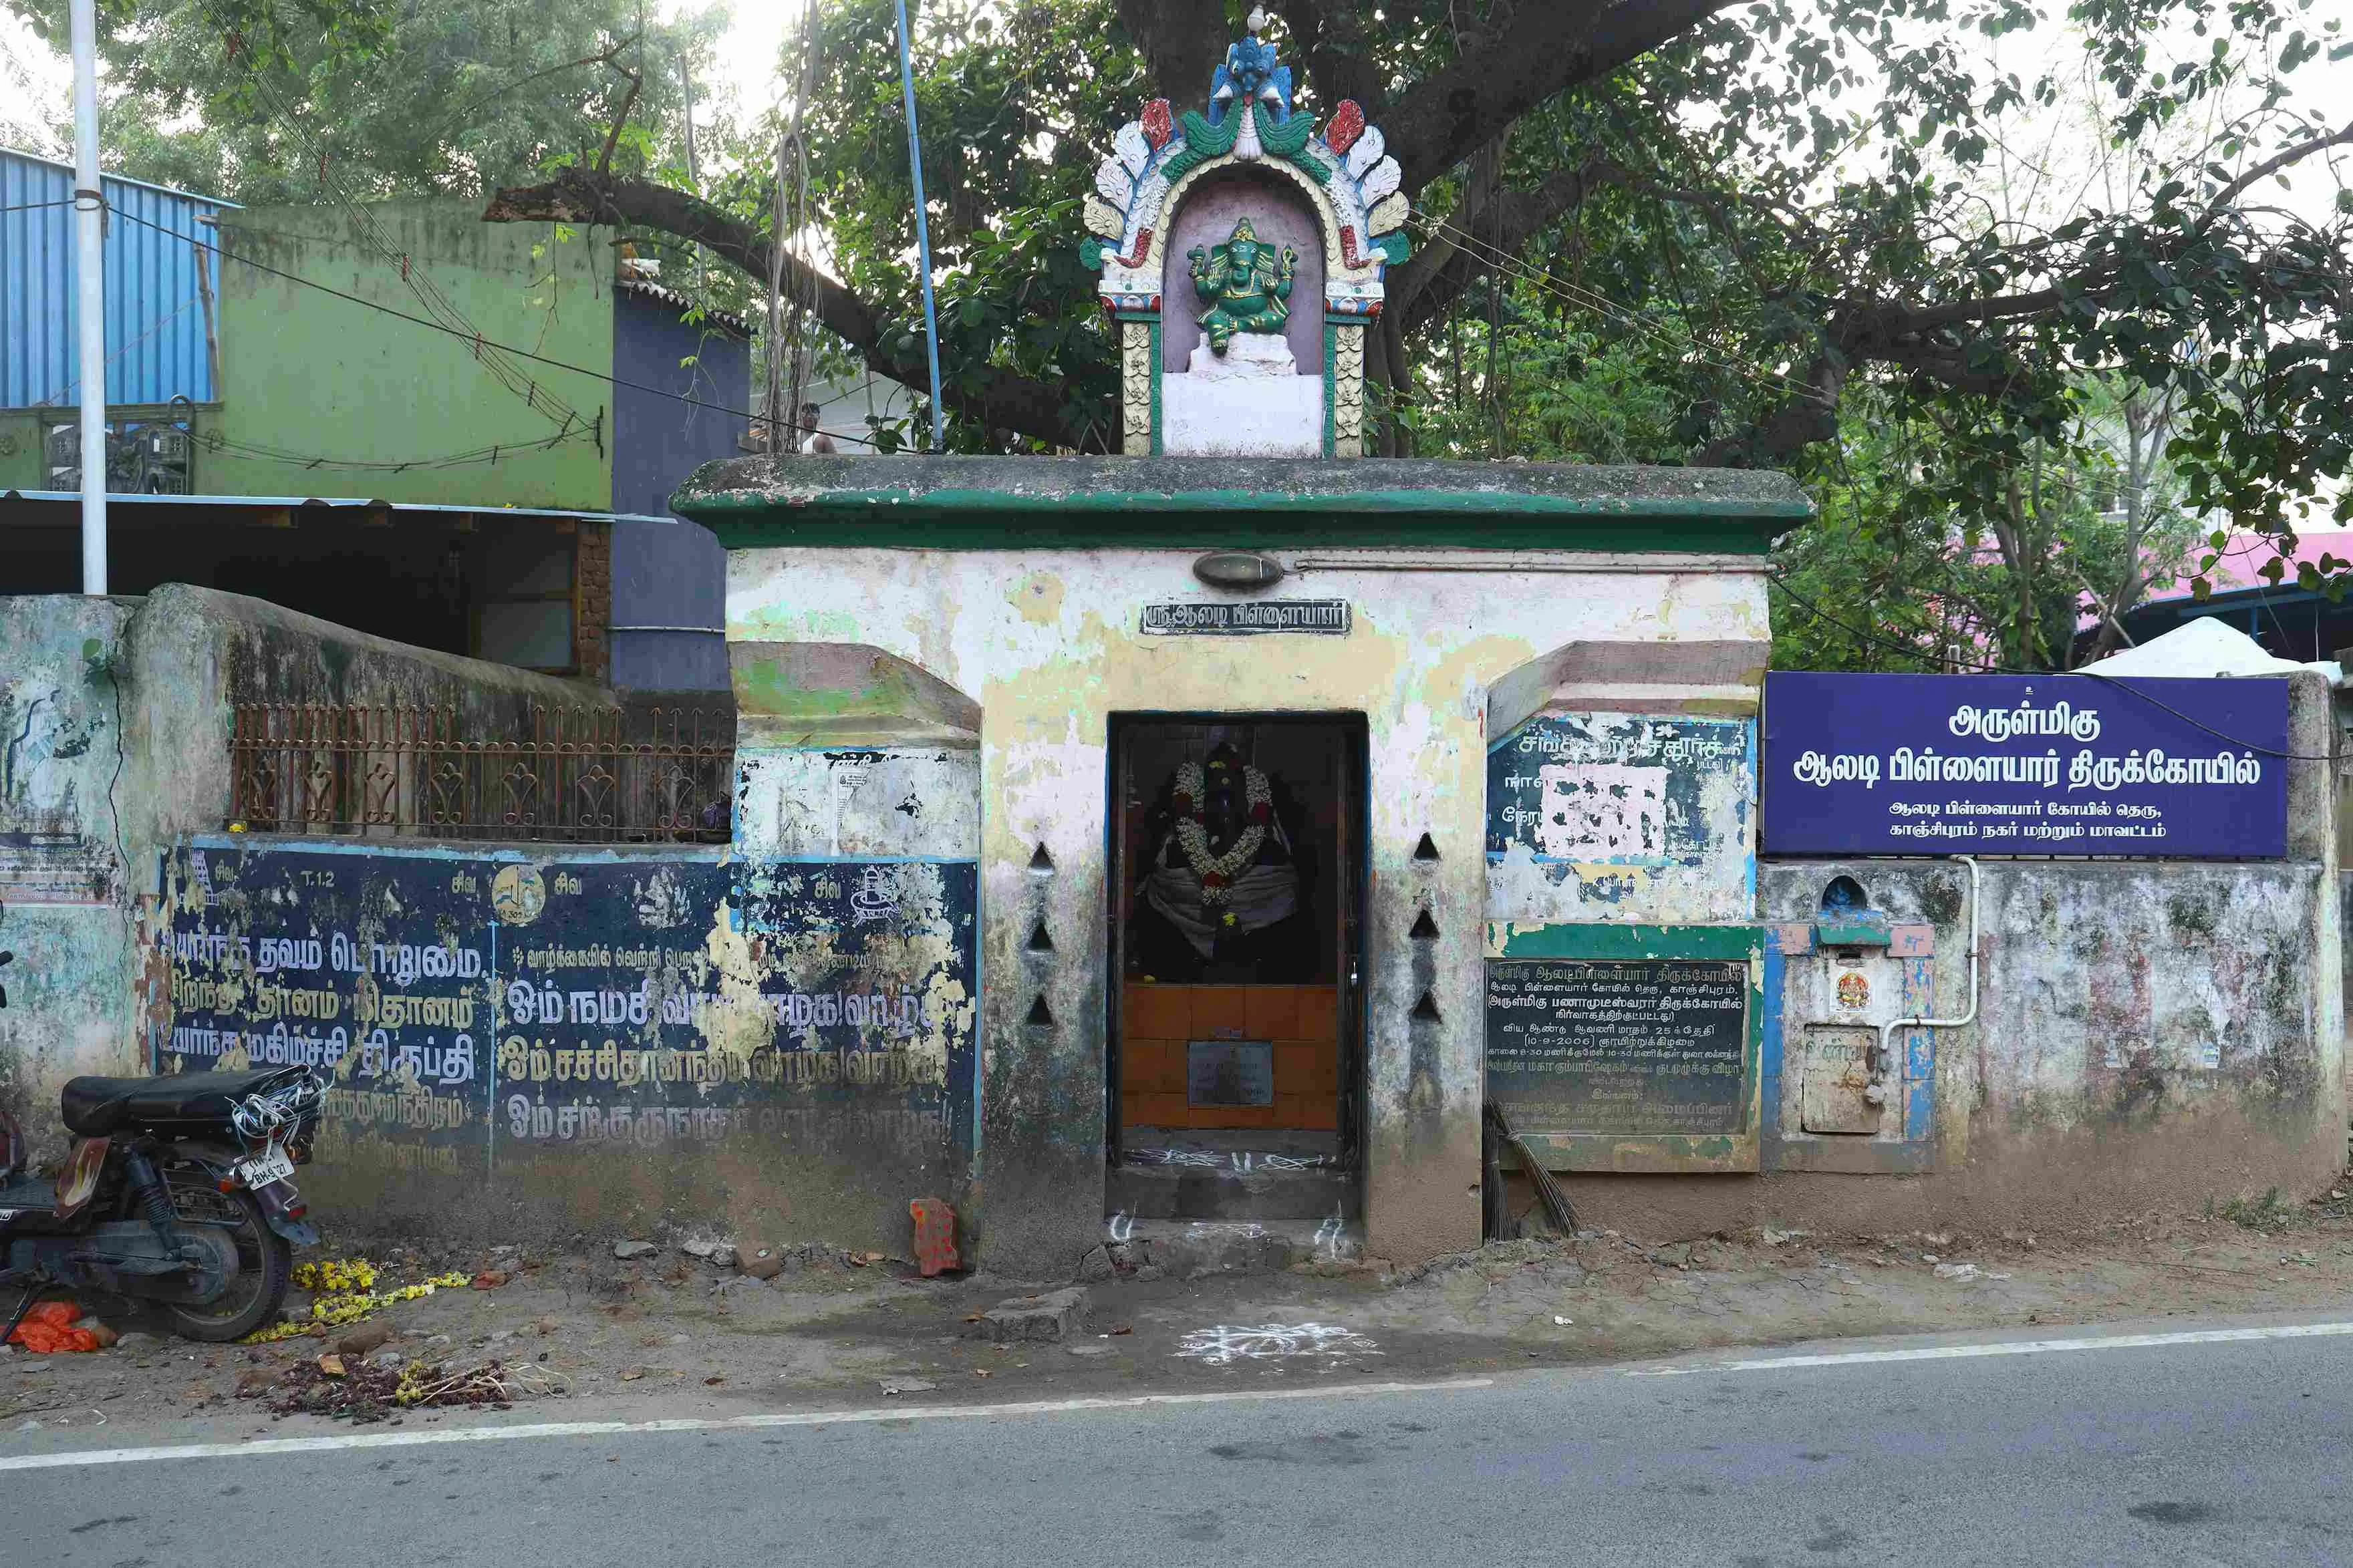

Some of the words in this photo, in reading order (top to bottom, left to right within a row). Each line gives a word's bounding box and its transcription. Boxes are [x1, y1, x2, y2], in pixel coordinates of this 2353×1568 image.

[1234, 602, 1343, 626] பிள்ளையார்
[1949, 699, 2100, 742] அருள்மிகு
[1793, 750, 1881, 789] ஆலடி
[1889, 746, 2061, 788] பிள்ளையார்
[2068, 748, 2261, 794] திருக்கோயில்
[1889, 802, 1941, 818] ஆலடி
[1945, 799, 2043, 816] பிள்ளையார்
[2047, 800, 2112, 816] கோயில்
[2116, 804, 2162, 820] தெரு,
[1889, 820, 1978, 839] காஞ்சிபுரம்
[1981, 820, 2019, 839] நகர்
[2024, 821, 2085, 840] மற்றும்
[2090, 822, 2167, 838] மாவட்டம்
[451, 869, 476, 894] சிவ
[554, 871, 583, 896] சிவ
[814, 876, 841, 899] சிவ
[527, 942, 611, 975] வாழ்க்கையில்
[615, 943, 662, 972] வெற்றி
[1524, 981, 1588, 992] பிள்ளையார்
[1592, 982, 1631, 993] கோயில்
[508, 979, 565, 1025] ஓம்
[1488, 993, 1547, 1009] (அருள்மிகு
[1657, 996, 1743, 1011] திருக்கோயில்
[1503, 1022, 1524, 1033] விய
[1528, 1022, 1567, 1034] ஆண்டு
[1574, 1024, 1615, 1034] ஆவணி
[1618, 1024, 1648, 1036] மாதம்
[1655, 1026, 1671, 1035] 25
[1599, 1036, 1695, 1050] ஞாயிற்றுக்கிழமை
[503, 1034, 552, 1081] ஓம்
[507, 1094, 554, 1138] ஓம்
